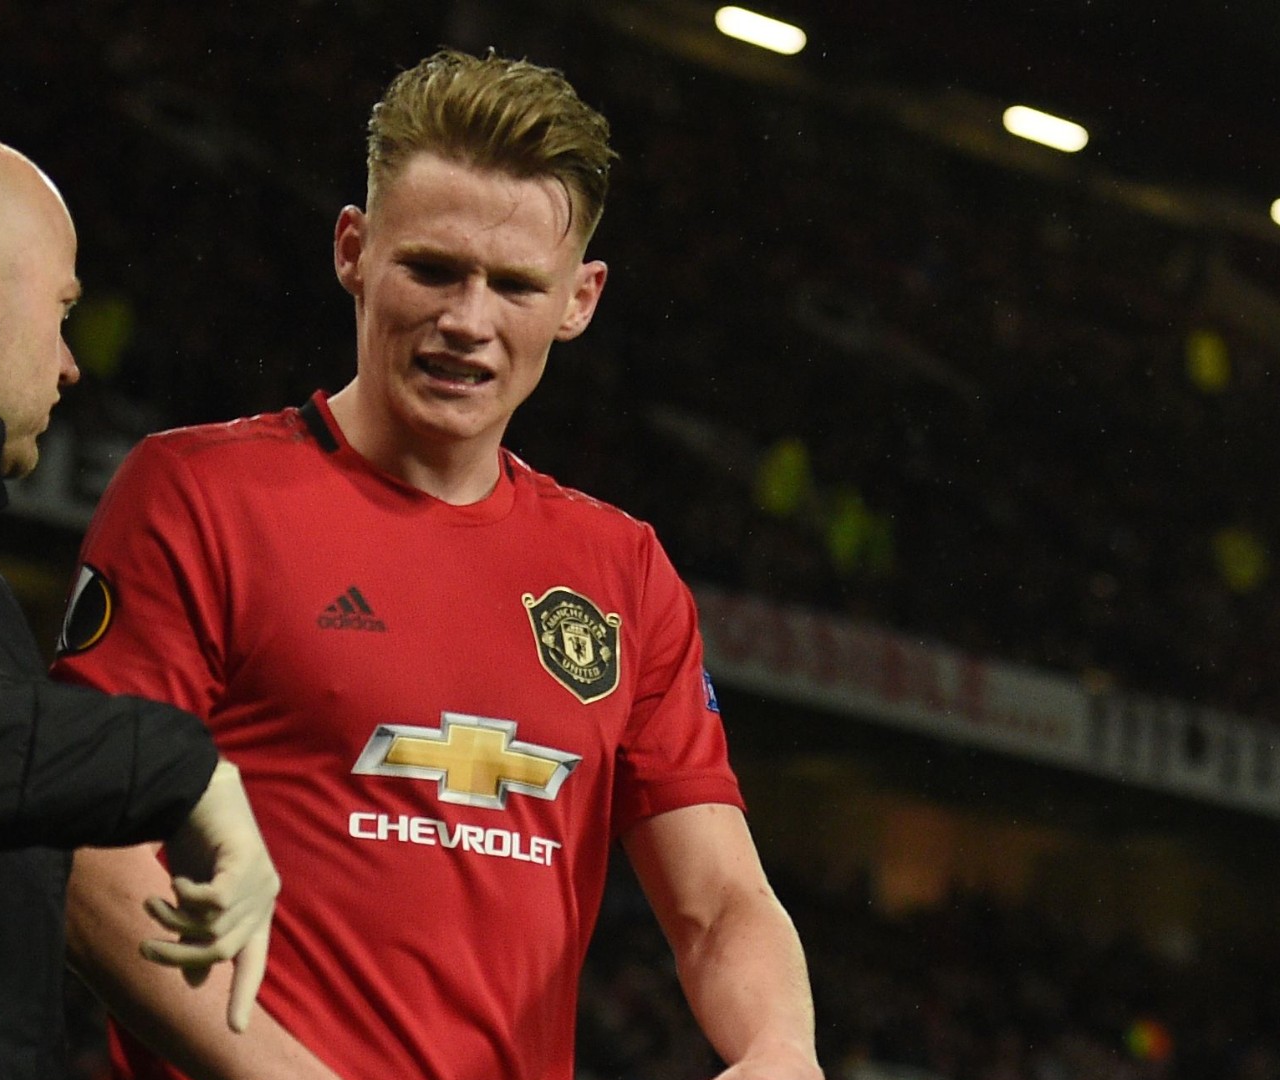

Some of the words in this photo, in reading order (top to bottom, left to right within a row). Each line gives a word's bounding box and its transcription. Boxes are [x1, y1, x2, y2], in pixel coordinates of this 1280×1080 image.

[317, 614, 386, 632] adidas
[546, 608, 607, 641] MANCHESTER
[562, 659, 601, 679] UNITED
[348, 812, 562, 867] CHEVROLET
